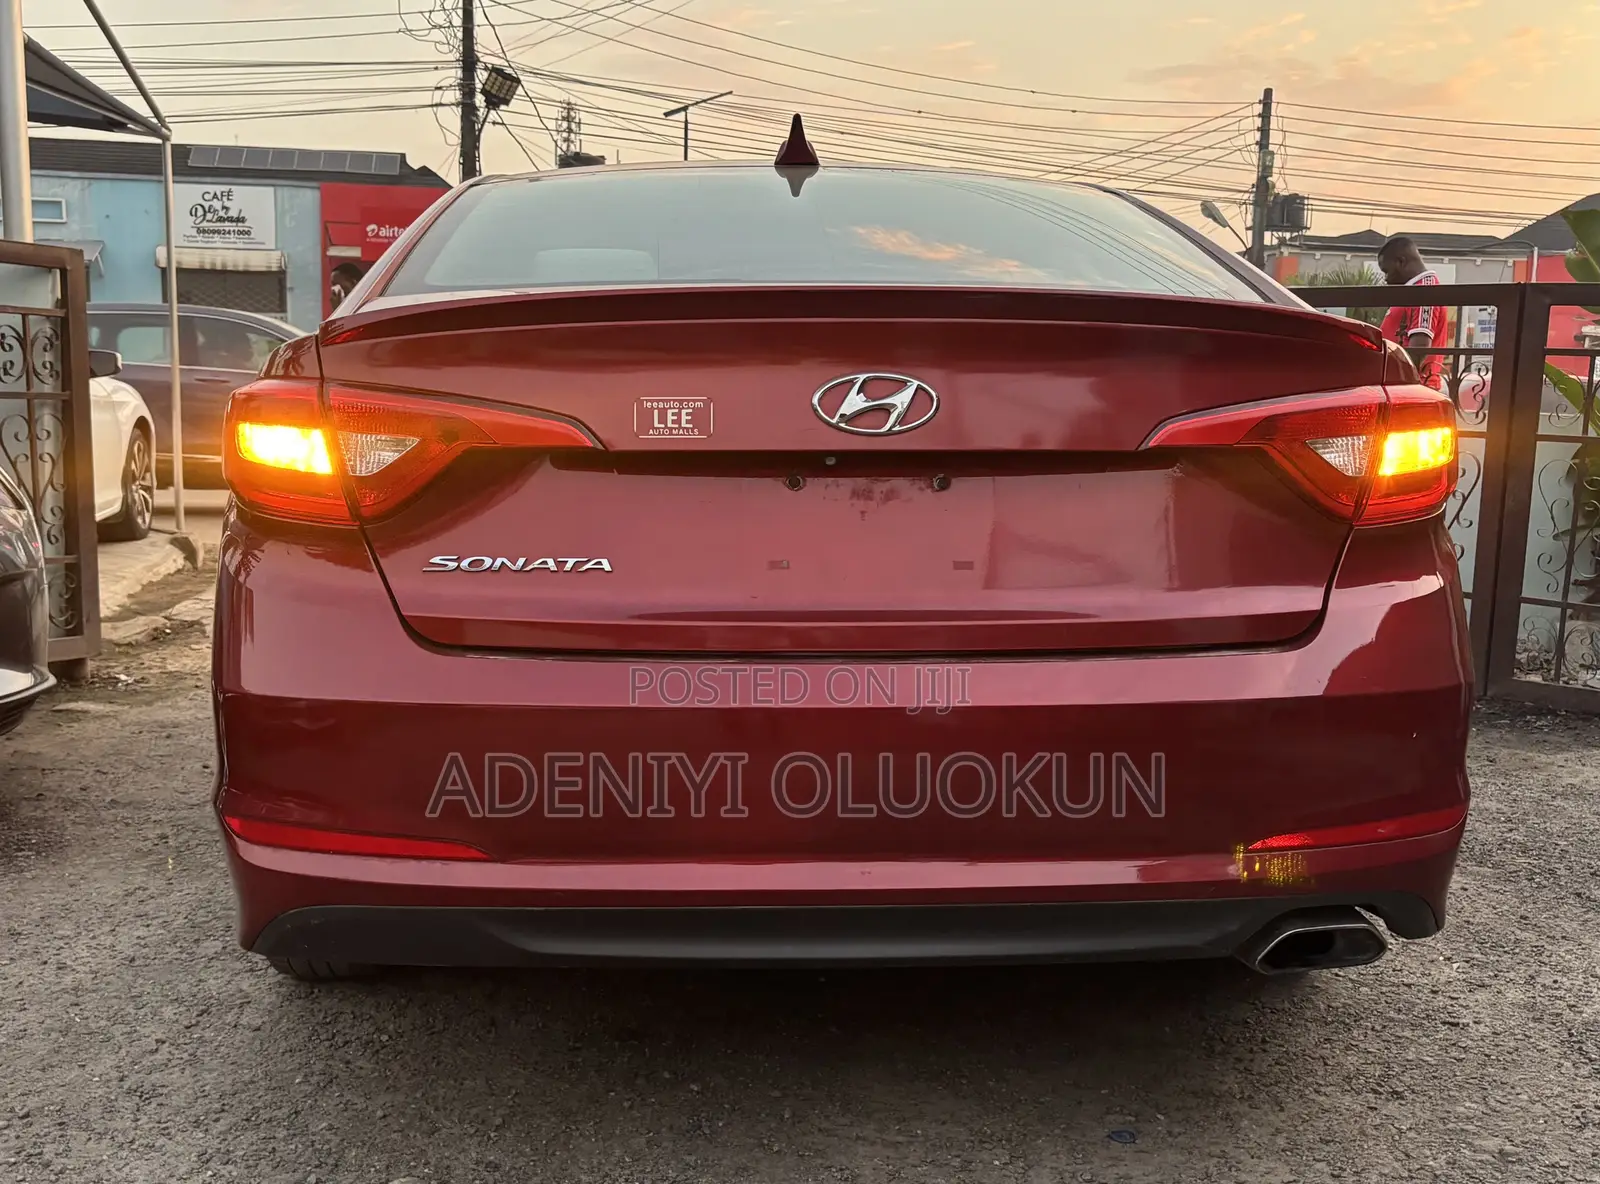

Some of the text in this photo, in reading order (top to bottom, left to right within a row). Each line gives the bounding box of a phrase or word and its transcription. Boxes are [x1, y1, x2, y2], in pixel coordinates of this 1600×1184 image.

[201, 188, 234, 202] CAFÉ
[379, 224, 407, 238] airte
[643, 400, 704, 409] leeauto.com
[653, 409, 693, 428] LEE
[648, 428, 699, 436] AUTO MALLS
[422, 556, 613, 573] SONATA
